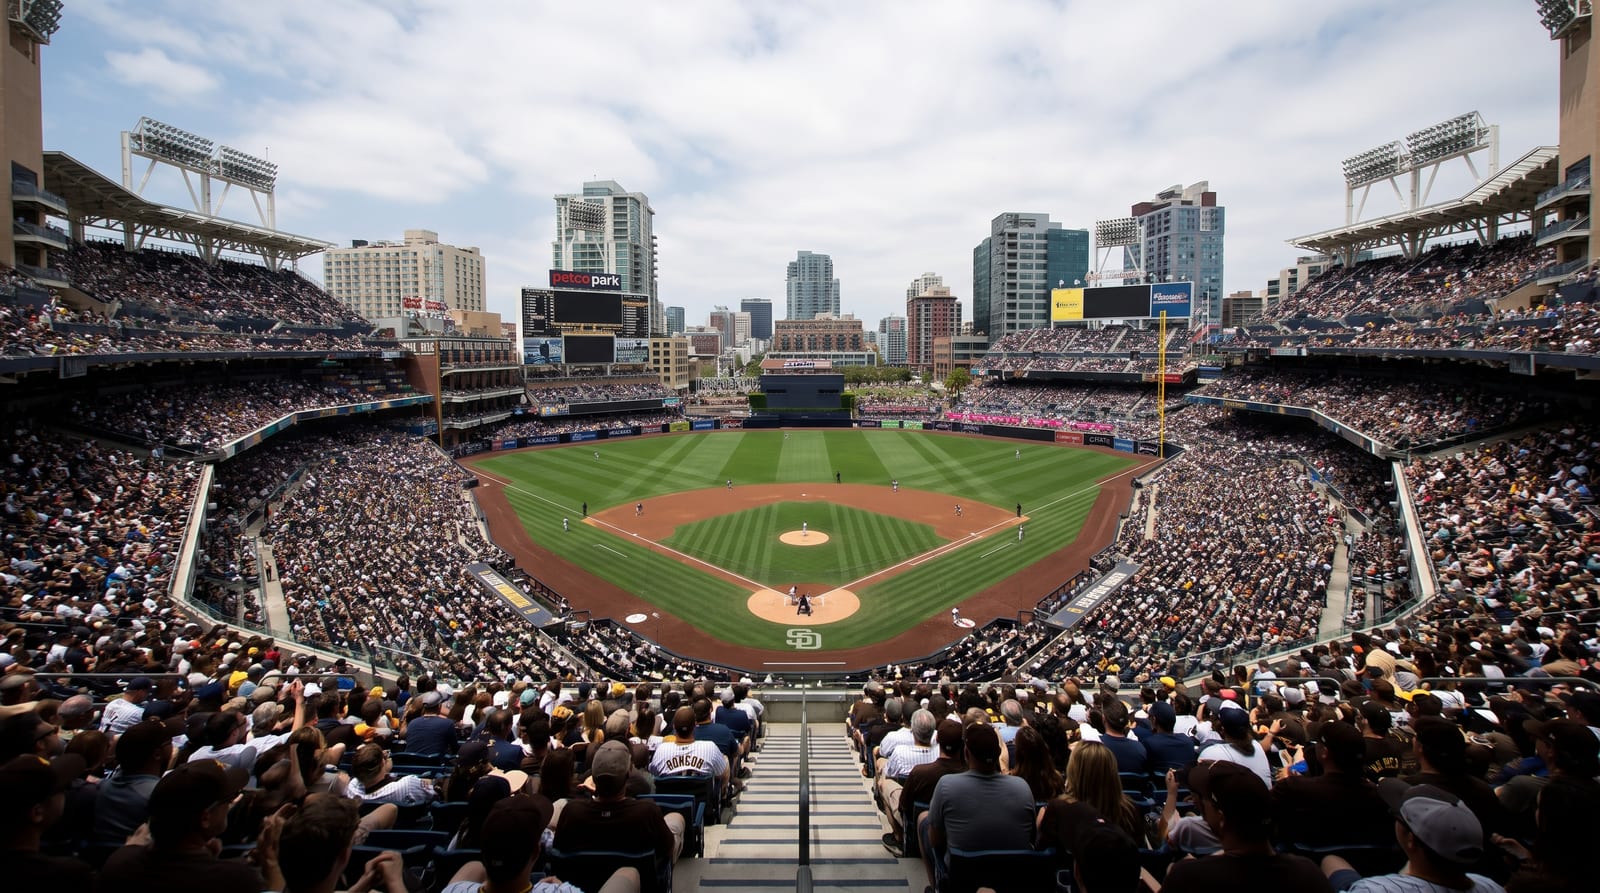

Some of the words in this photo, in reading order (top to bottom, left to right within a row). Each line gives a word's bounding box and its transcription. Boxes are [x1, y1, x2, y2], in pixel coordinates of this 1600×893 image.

[552, 272, 590, 285] petco
[592, 275, 620, 287] park
[786, 628, 822, 649] SD
